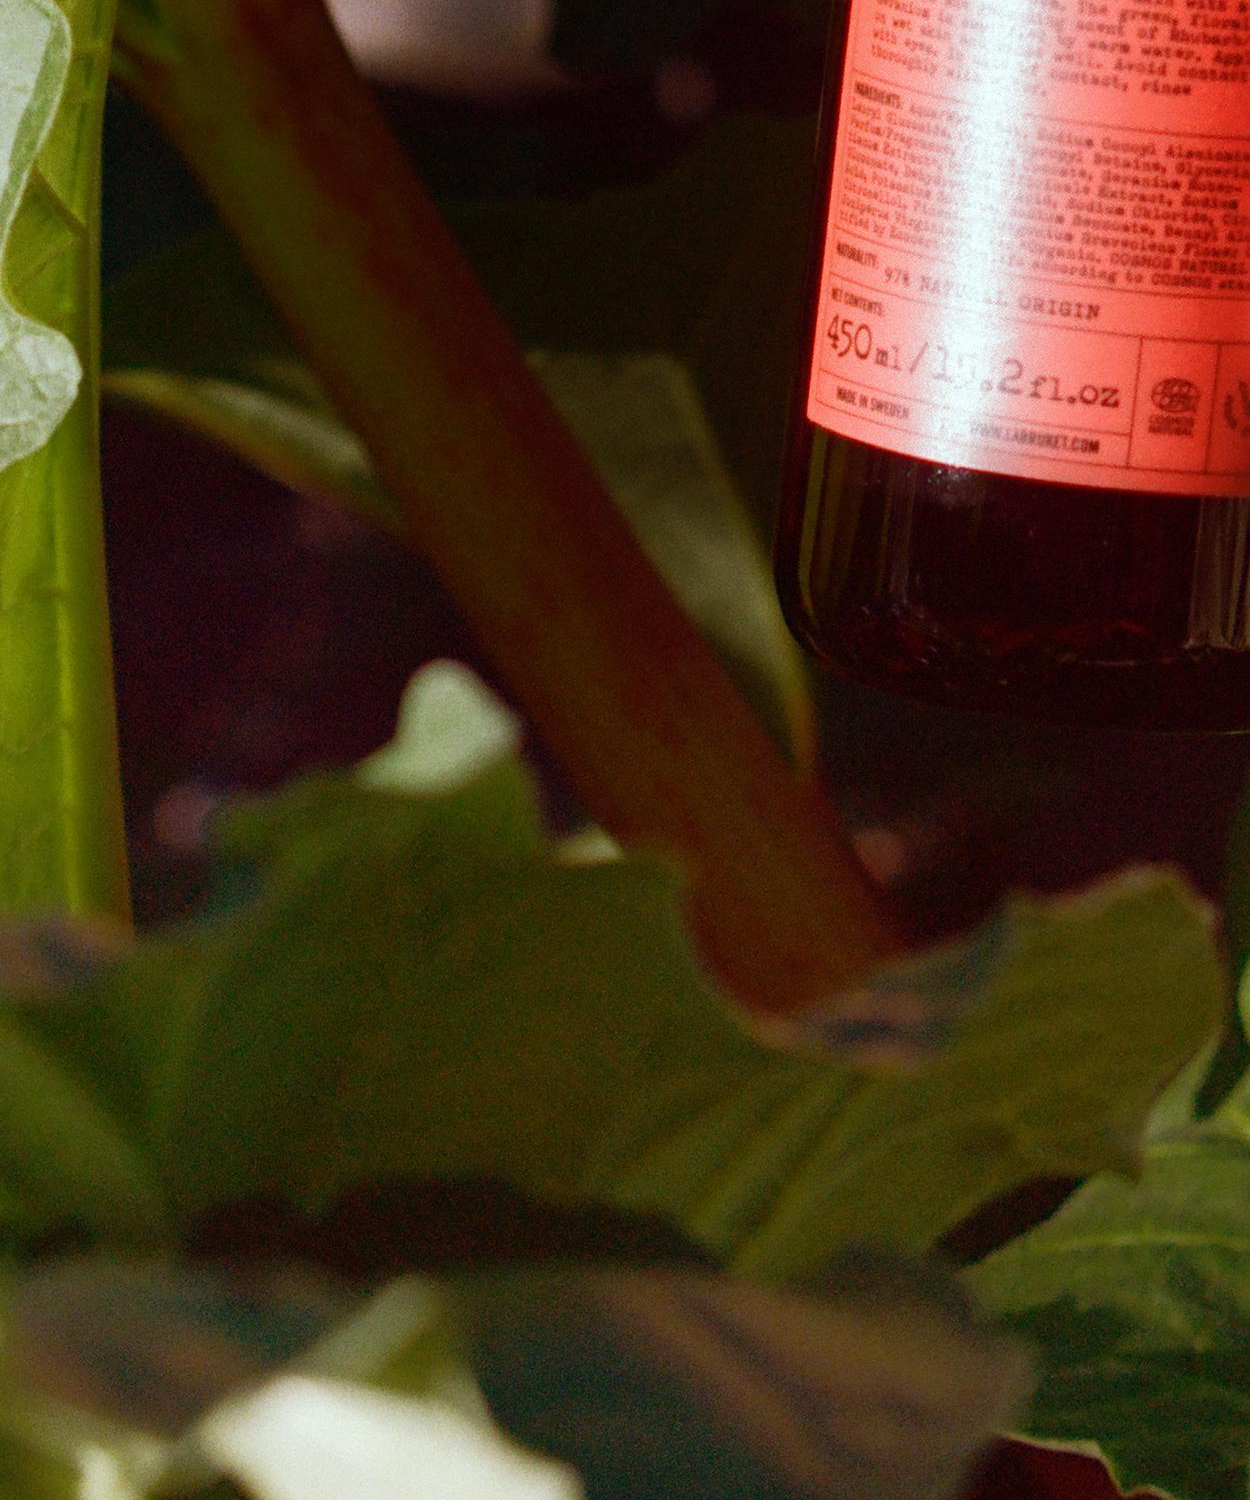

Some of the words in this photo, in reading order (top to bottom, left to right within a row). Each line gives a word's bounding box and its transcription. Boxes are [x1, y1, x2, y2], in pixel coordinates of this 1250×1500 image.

[919, 273, 1010, 308] NATUAL
[1016, 293, 1100, 322] ORIGIN
[835, 385, 857, 406] MADE
[857, 392, 869, 410] IN
[869, 396, 911, 420] SWEDEN
